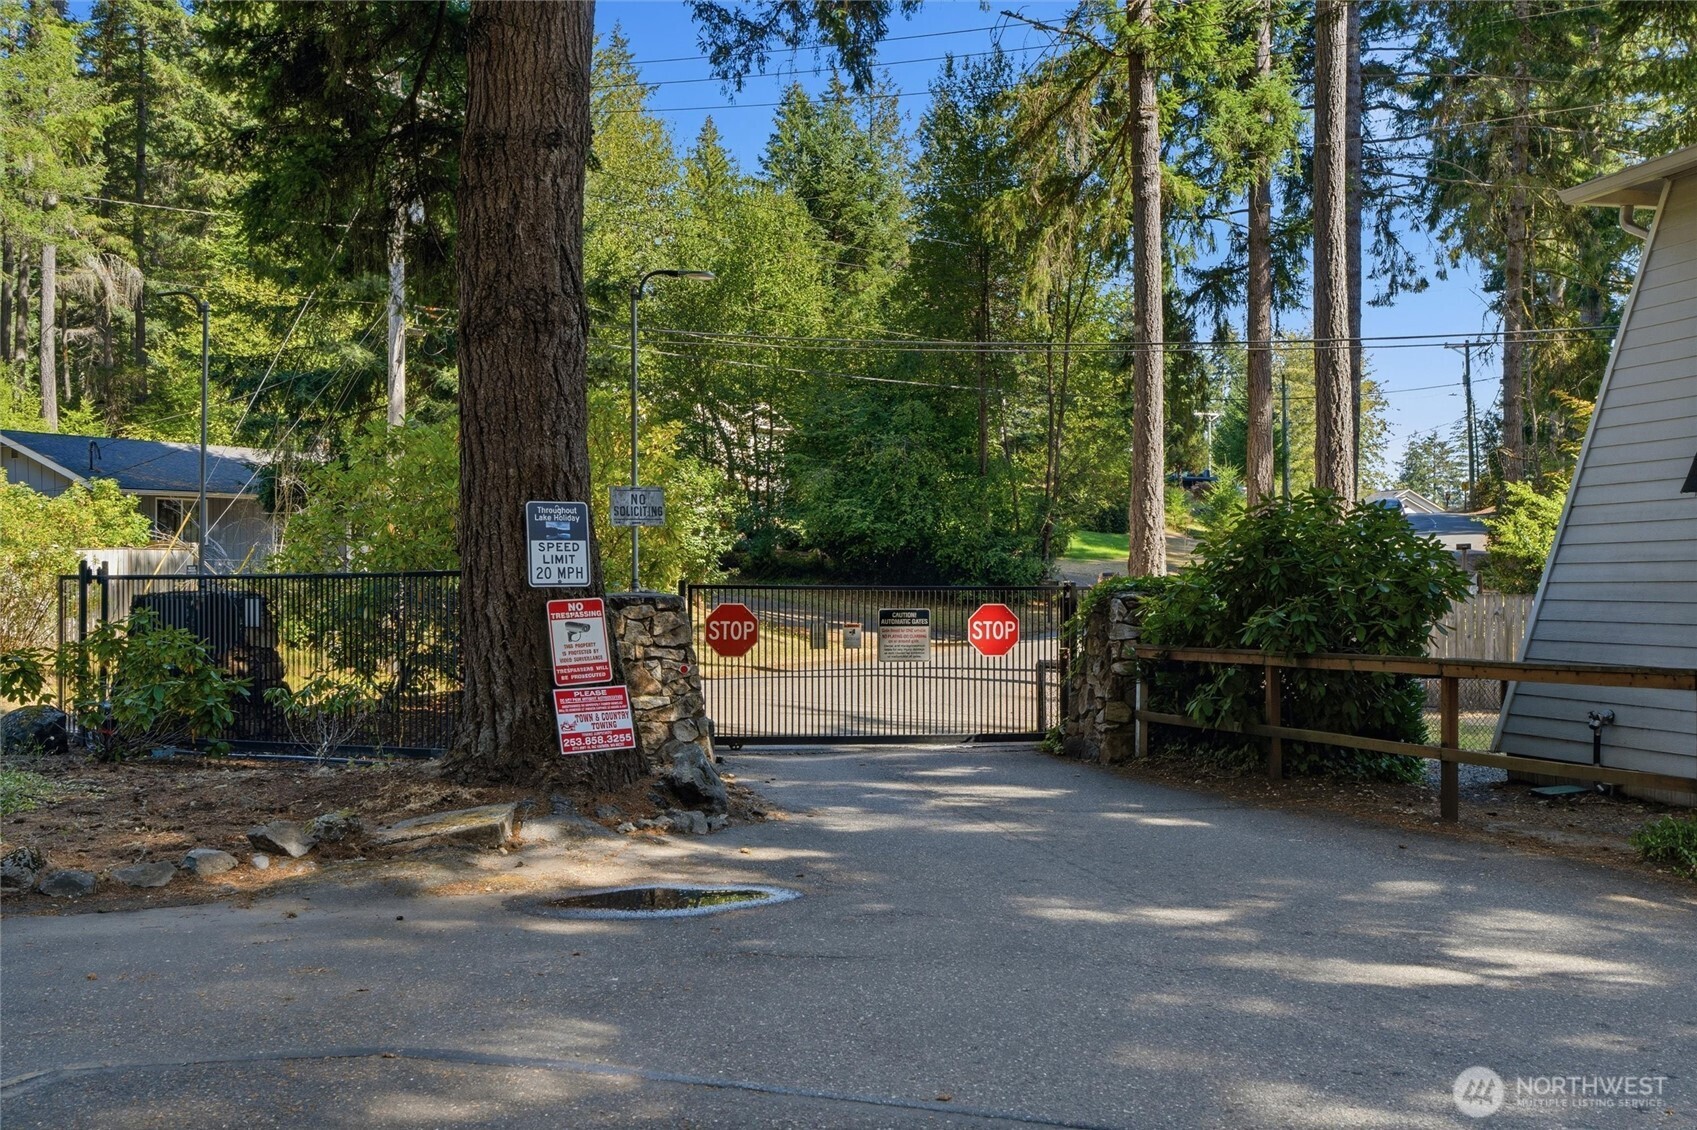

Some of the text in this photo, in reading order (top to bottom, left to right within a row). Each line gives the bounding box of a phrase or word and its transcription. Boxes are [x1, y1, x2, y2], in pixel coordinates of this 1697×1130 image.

[630, 494, 646, 505] NO
[537, 506, 577, 515] Throughout
[614, 506, 663, 516] SOLICITING
[554, 514, 580, 523] Holiday
[538, 542, 580, 552] SPEED
[542, 554, 576, 564] LIMIT
[536, 566, 584, 580] 20 MPH
[568, 602, 584, 612] NO
[550, 610, 602, 620] TRESPASSING
[708, 621, 755, 640] STOP
[972, 621, 1016, 640] STOP
[556, 666, 594, 674] TRESPASSERS
[575, 711, 629, 723] TOWN & COUNTRY
[591, 721, 617, 730] TOWING
[564, 733, 632, 747] 253.858.3255
